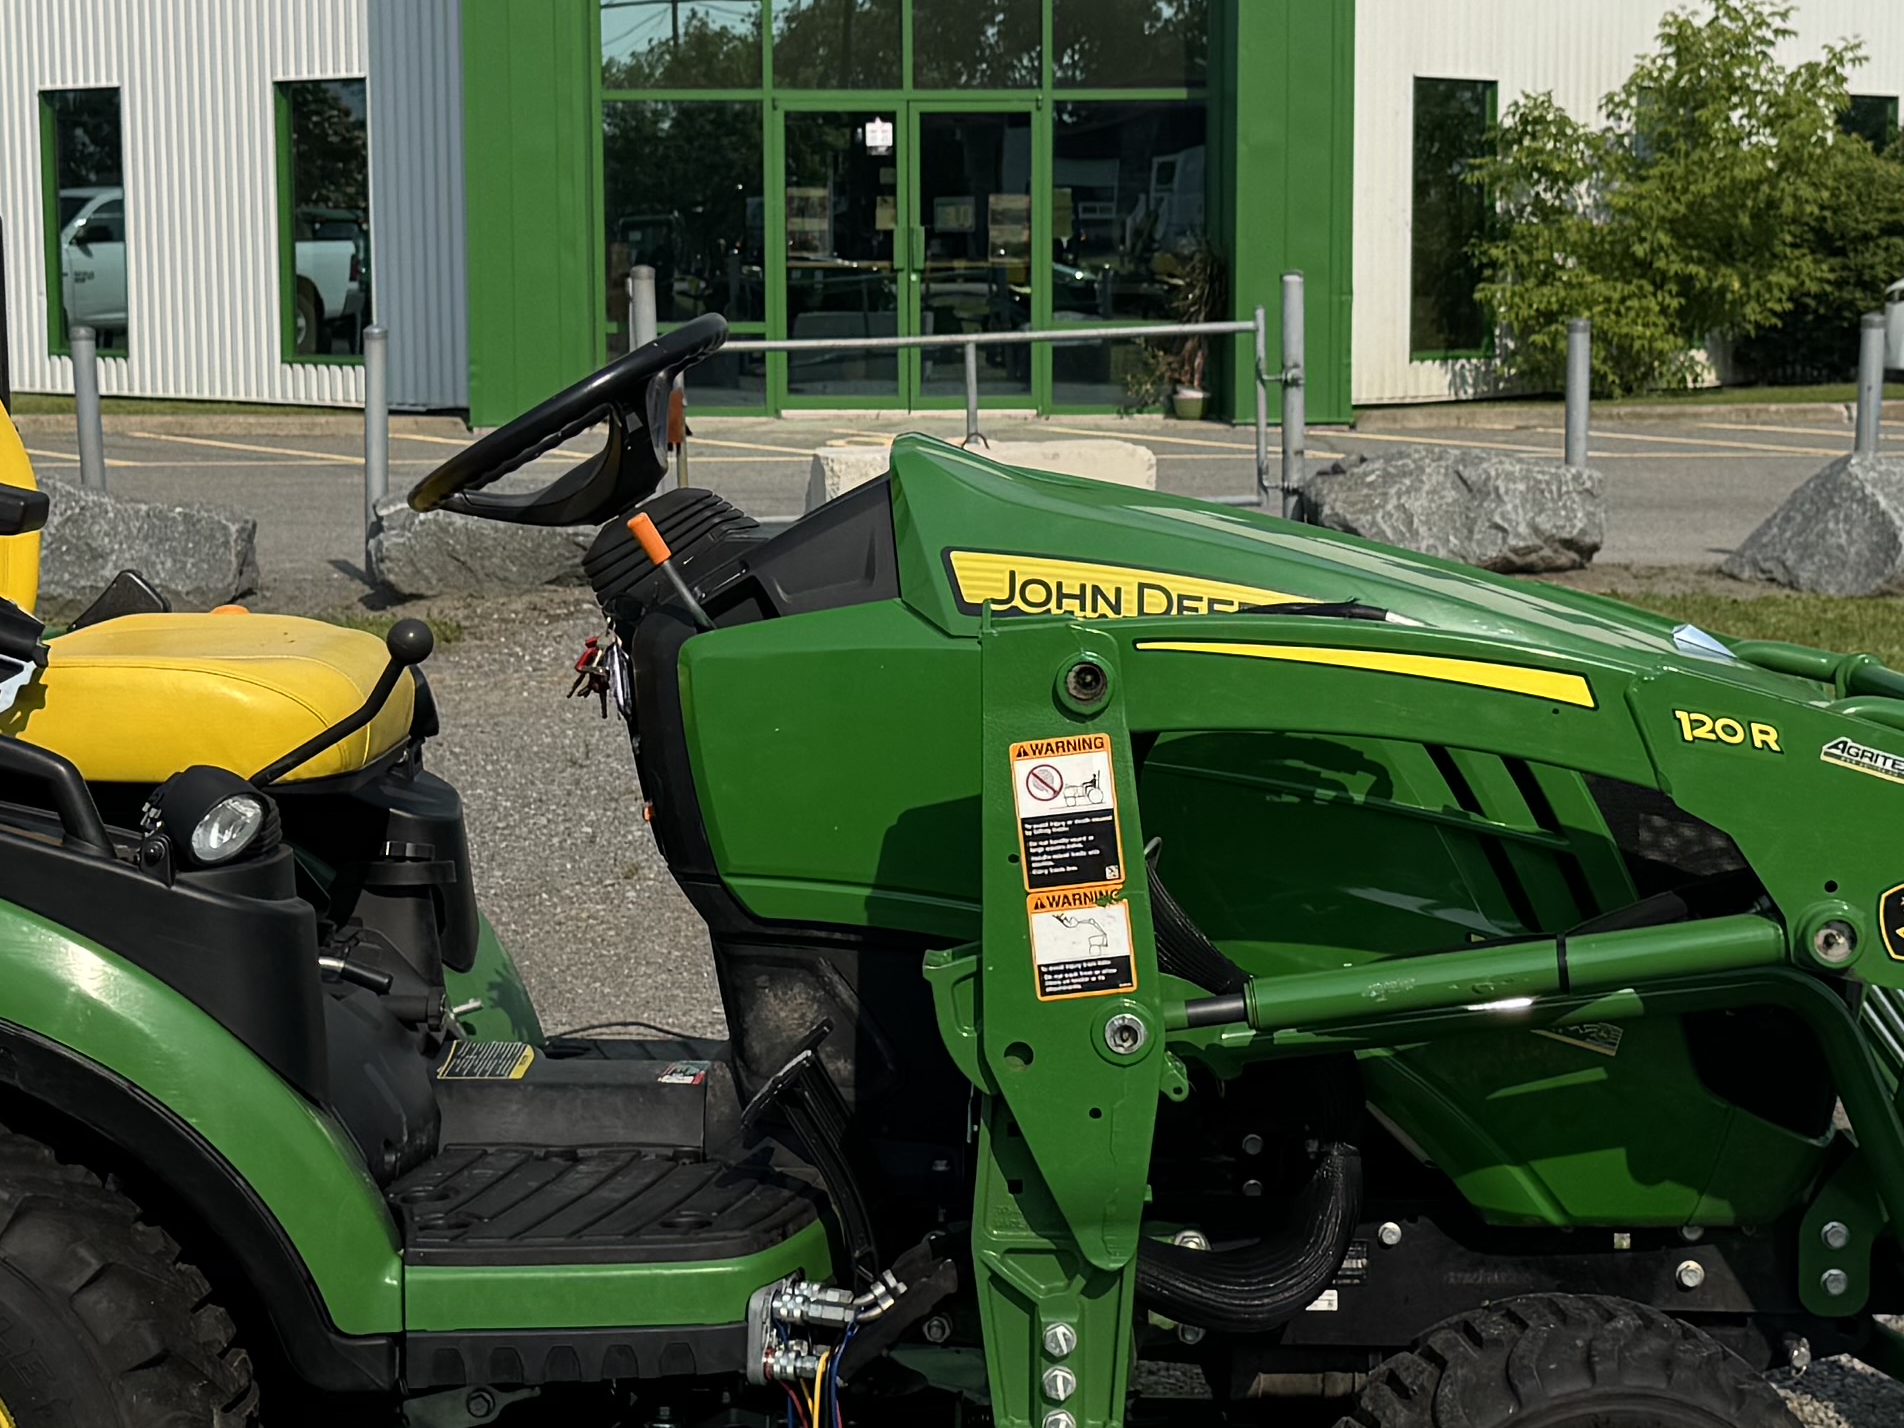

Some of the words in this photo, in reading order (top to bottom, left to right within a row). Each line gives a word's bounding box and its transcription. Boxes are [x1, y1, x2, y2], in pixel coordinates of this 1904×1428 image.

[989, 569, 1123, 617] JOHN
[1137, 581, 1246, 616] DEE
[1029, 736, 1105, 756] WARNING
[1673, 708, 1746, 746] 120
[1749, 720, 1784, 754] R
